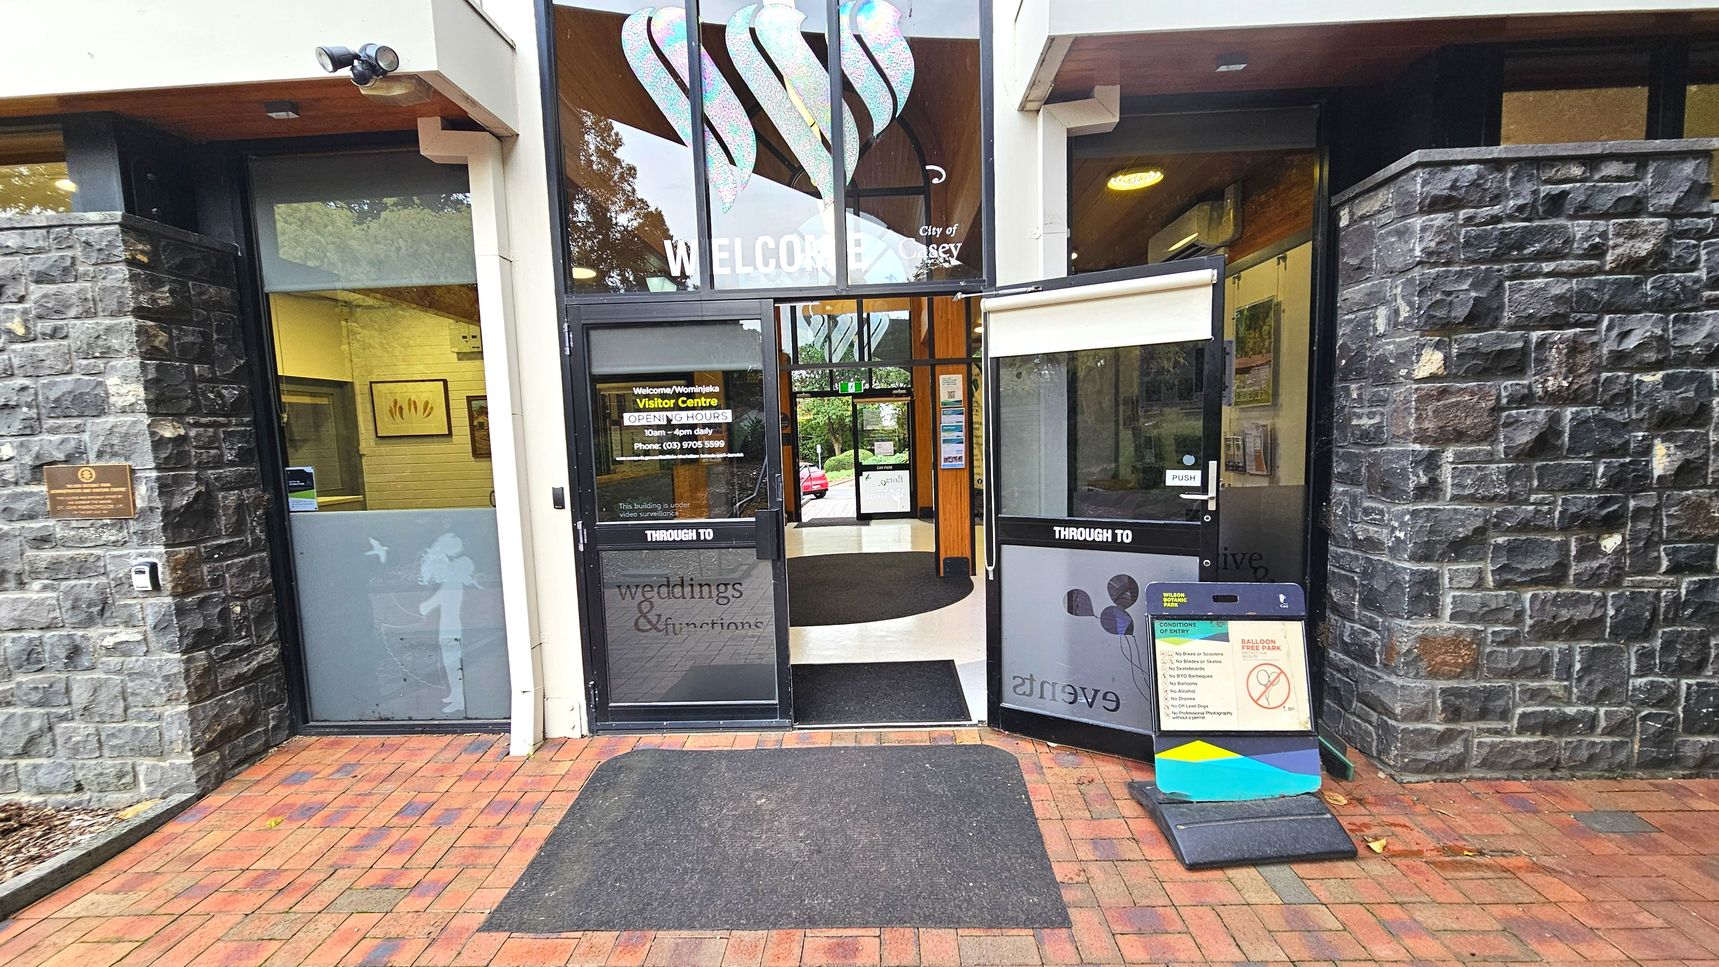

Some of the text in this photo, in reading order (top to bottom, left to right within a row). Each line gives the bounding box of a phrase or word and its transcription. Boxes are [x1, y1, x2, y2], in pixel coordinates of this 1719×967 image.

[920, 224, 958, 238] City of
[898, 238, 962, 262] Casey
[632, 384, 720, 395] Welcome/Wominjeka
[636, 396, 718, 409] Visitor Centre
[628, 411, 728, 424] OPENING HOURS
[644, 429, 666, 437] 10am
[673, 428, 692, 436] 4pm
[694, 426, 714, 436] daily
[634, 440, 725, 450] Phone: (03) 9705 5599
[1172, 474, 1196, 482] PUSH
[619, 502, 632, 510] This
[634, 502, 662, 510] building
[640, 510, 679, 518] surveillance
[645, 528, 714, 542] THROUGH TO
[1053, 526, 1132, 543] THROUGH TO
[616, 576, 744, 606] weddings
[633, 600, 665, 633] &
